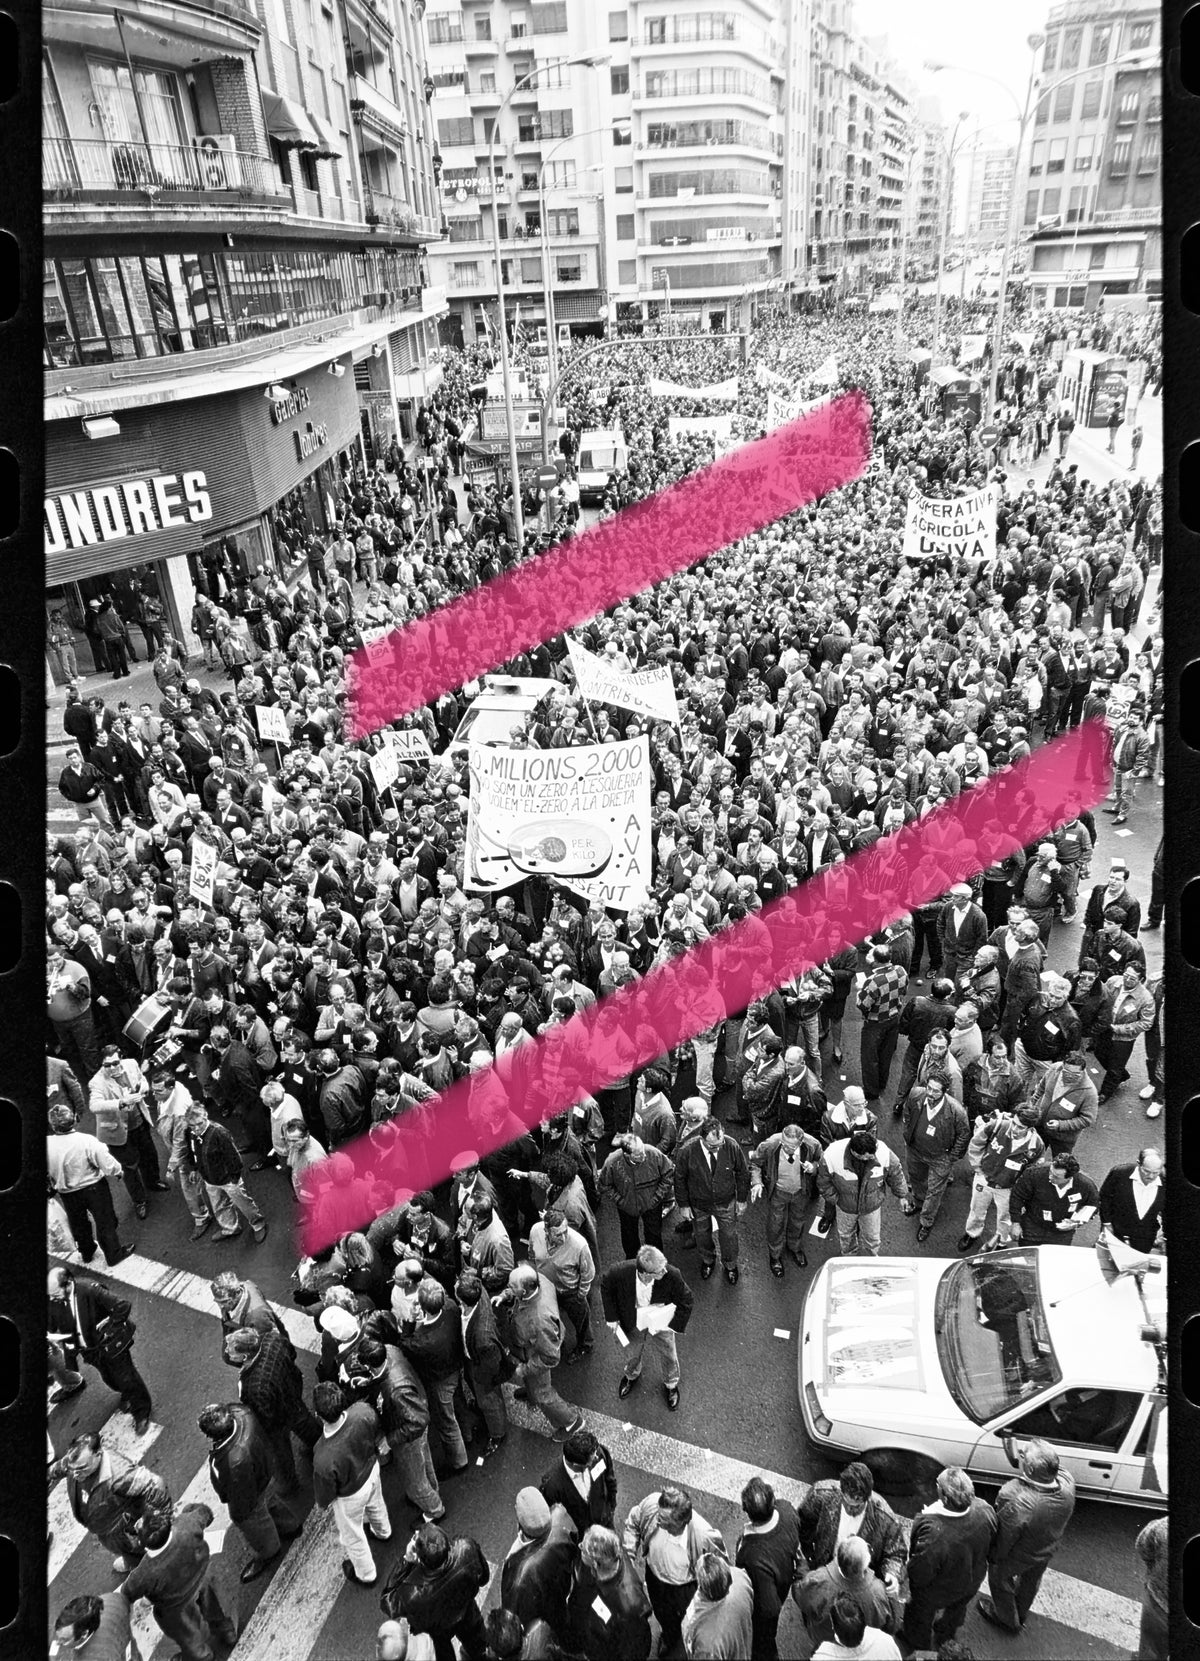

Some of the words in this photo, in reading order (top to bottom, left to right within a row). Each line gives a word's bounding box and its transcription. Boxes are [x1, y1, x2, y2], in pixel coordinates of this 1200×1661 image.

[912, 515, 986, 538] AGRICOLA
[1107, 706, 1127, 720] UPA
[393, 732, 422, 749] AVA
[490, 755, 577, 781] MILIONS
[493, 780, 516, 797] SOM
[519, 783, 536, 798] UN
[538, 782, 568, 798] ZERO
[570, 781, 579, 796] A
[523, 799, 537, 813] EL
[540, 798, 568, 814] ZERO
[571, 797, 580, 812] A
[582, 794, 597, 811] LA
[602, 789, 635, 809] DRETA
[572, 838, 594, 849] PER
[573, 850, 596, 860] KILO
